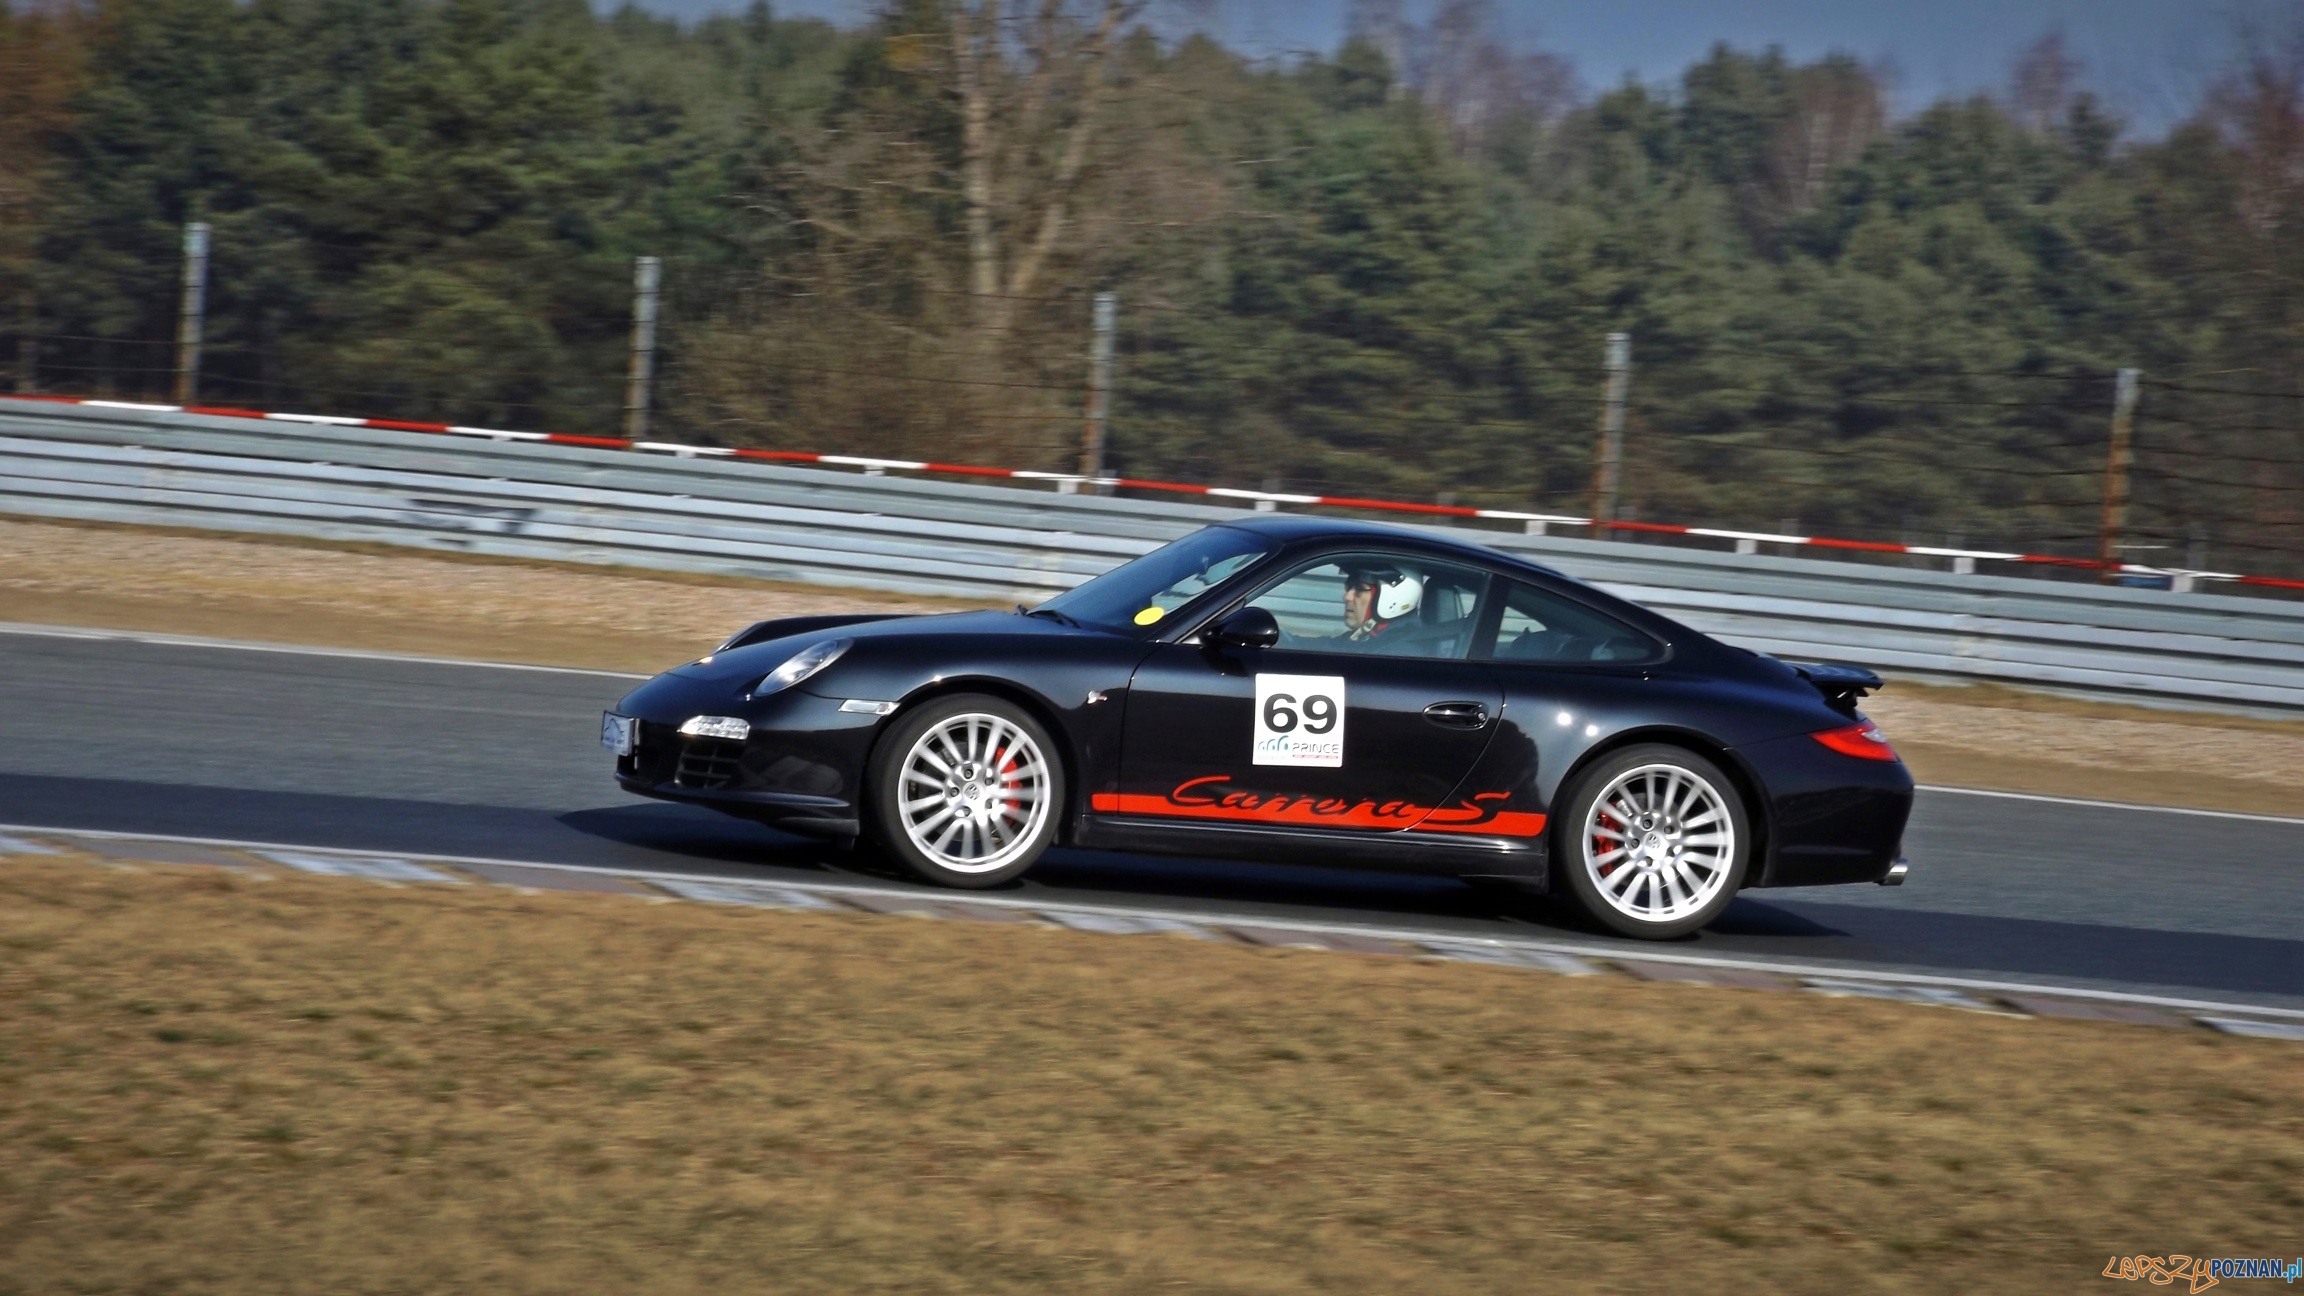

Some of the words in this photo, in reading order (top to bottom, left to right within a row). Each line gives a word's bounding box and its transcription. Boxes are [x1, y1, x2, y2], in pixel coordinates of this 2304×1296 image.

[1263, 693, 1337, 734] 69
[1292, 742, 1339, 754] PRINCE
[1173, 776, 1412, 818] Carrera
[1430, 791, 1511, 826] S
